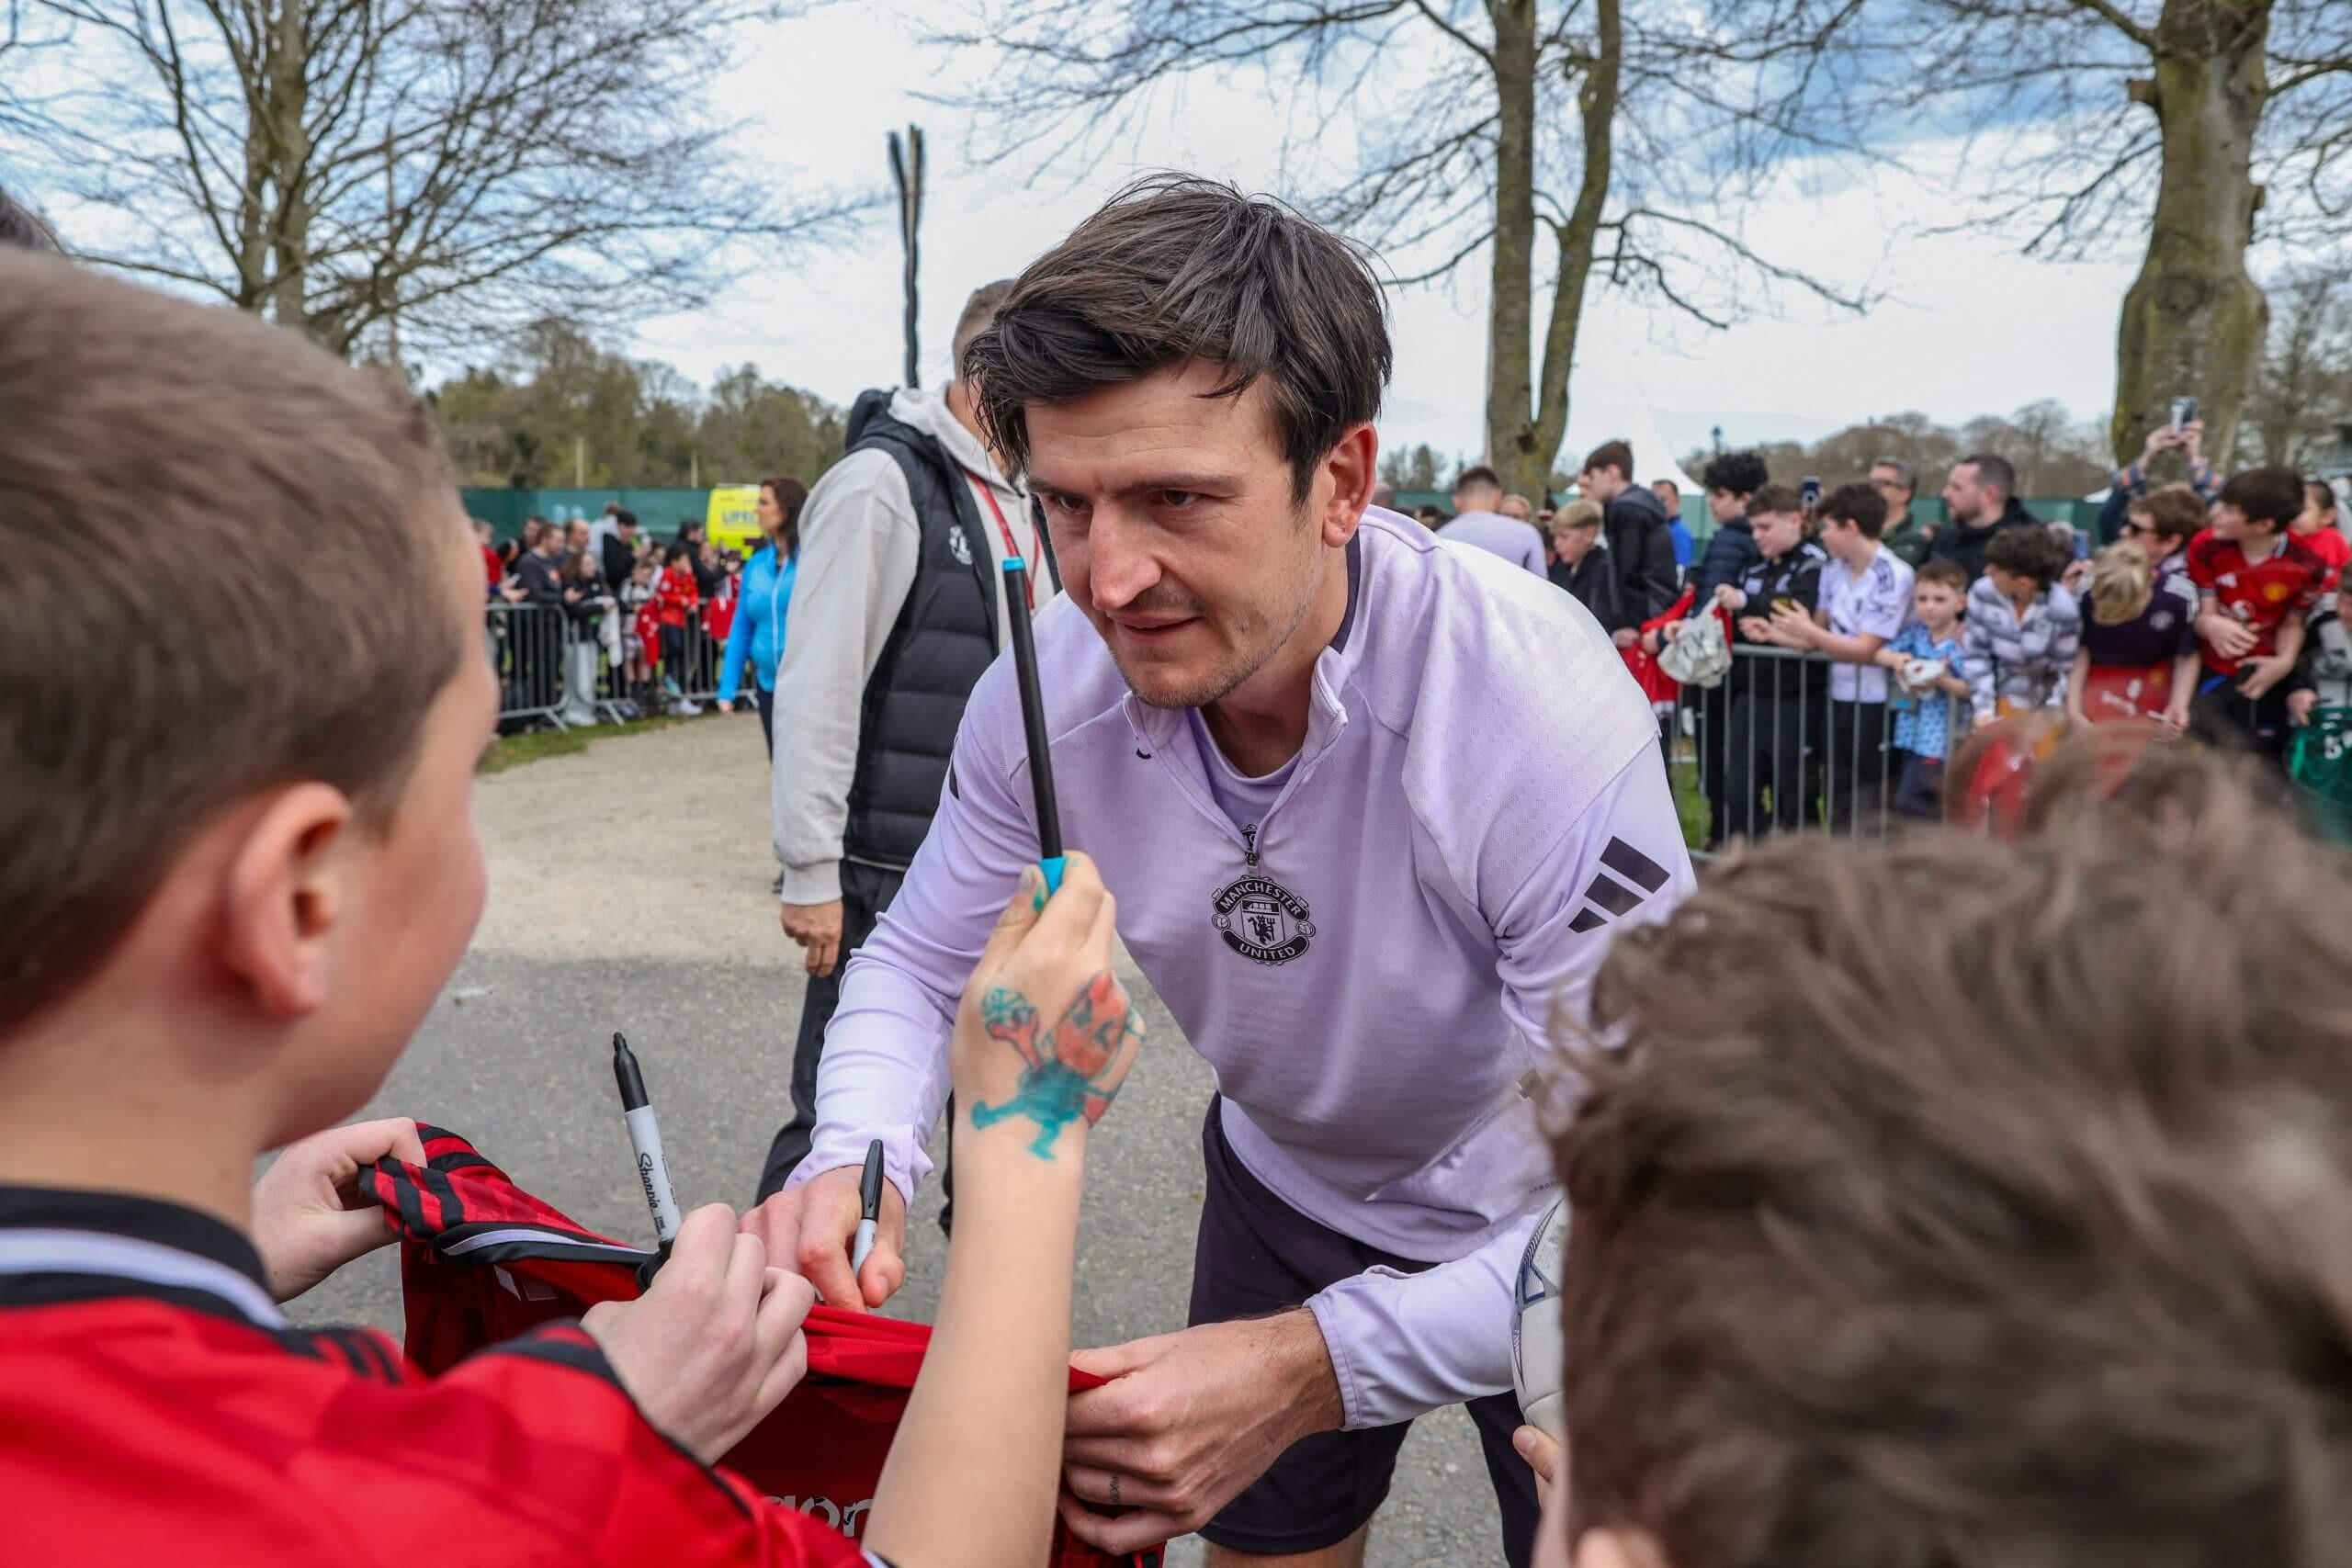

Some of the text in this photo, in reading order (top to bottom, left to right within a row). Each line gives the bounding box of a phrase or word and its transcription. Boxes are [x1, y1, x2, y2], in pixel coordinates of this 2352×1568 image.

[1220, 882, 1302, 916] MANCHESTER
[1239, 943, 1295, 960] UNITED
[639, 1151, 661, 1210] Sharpie
